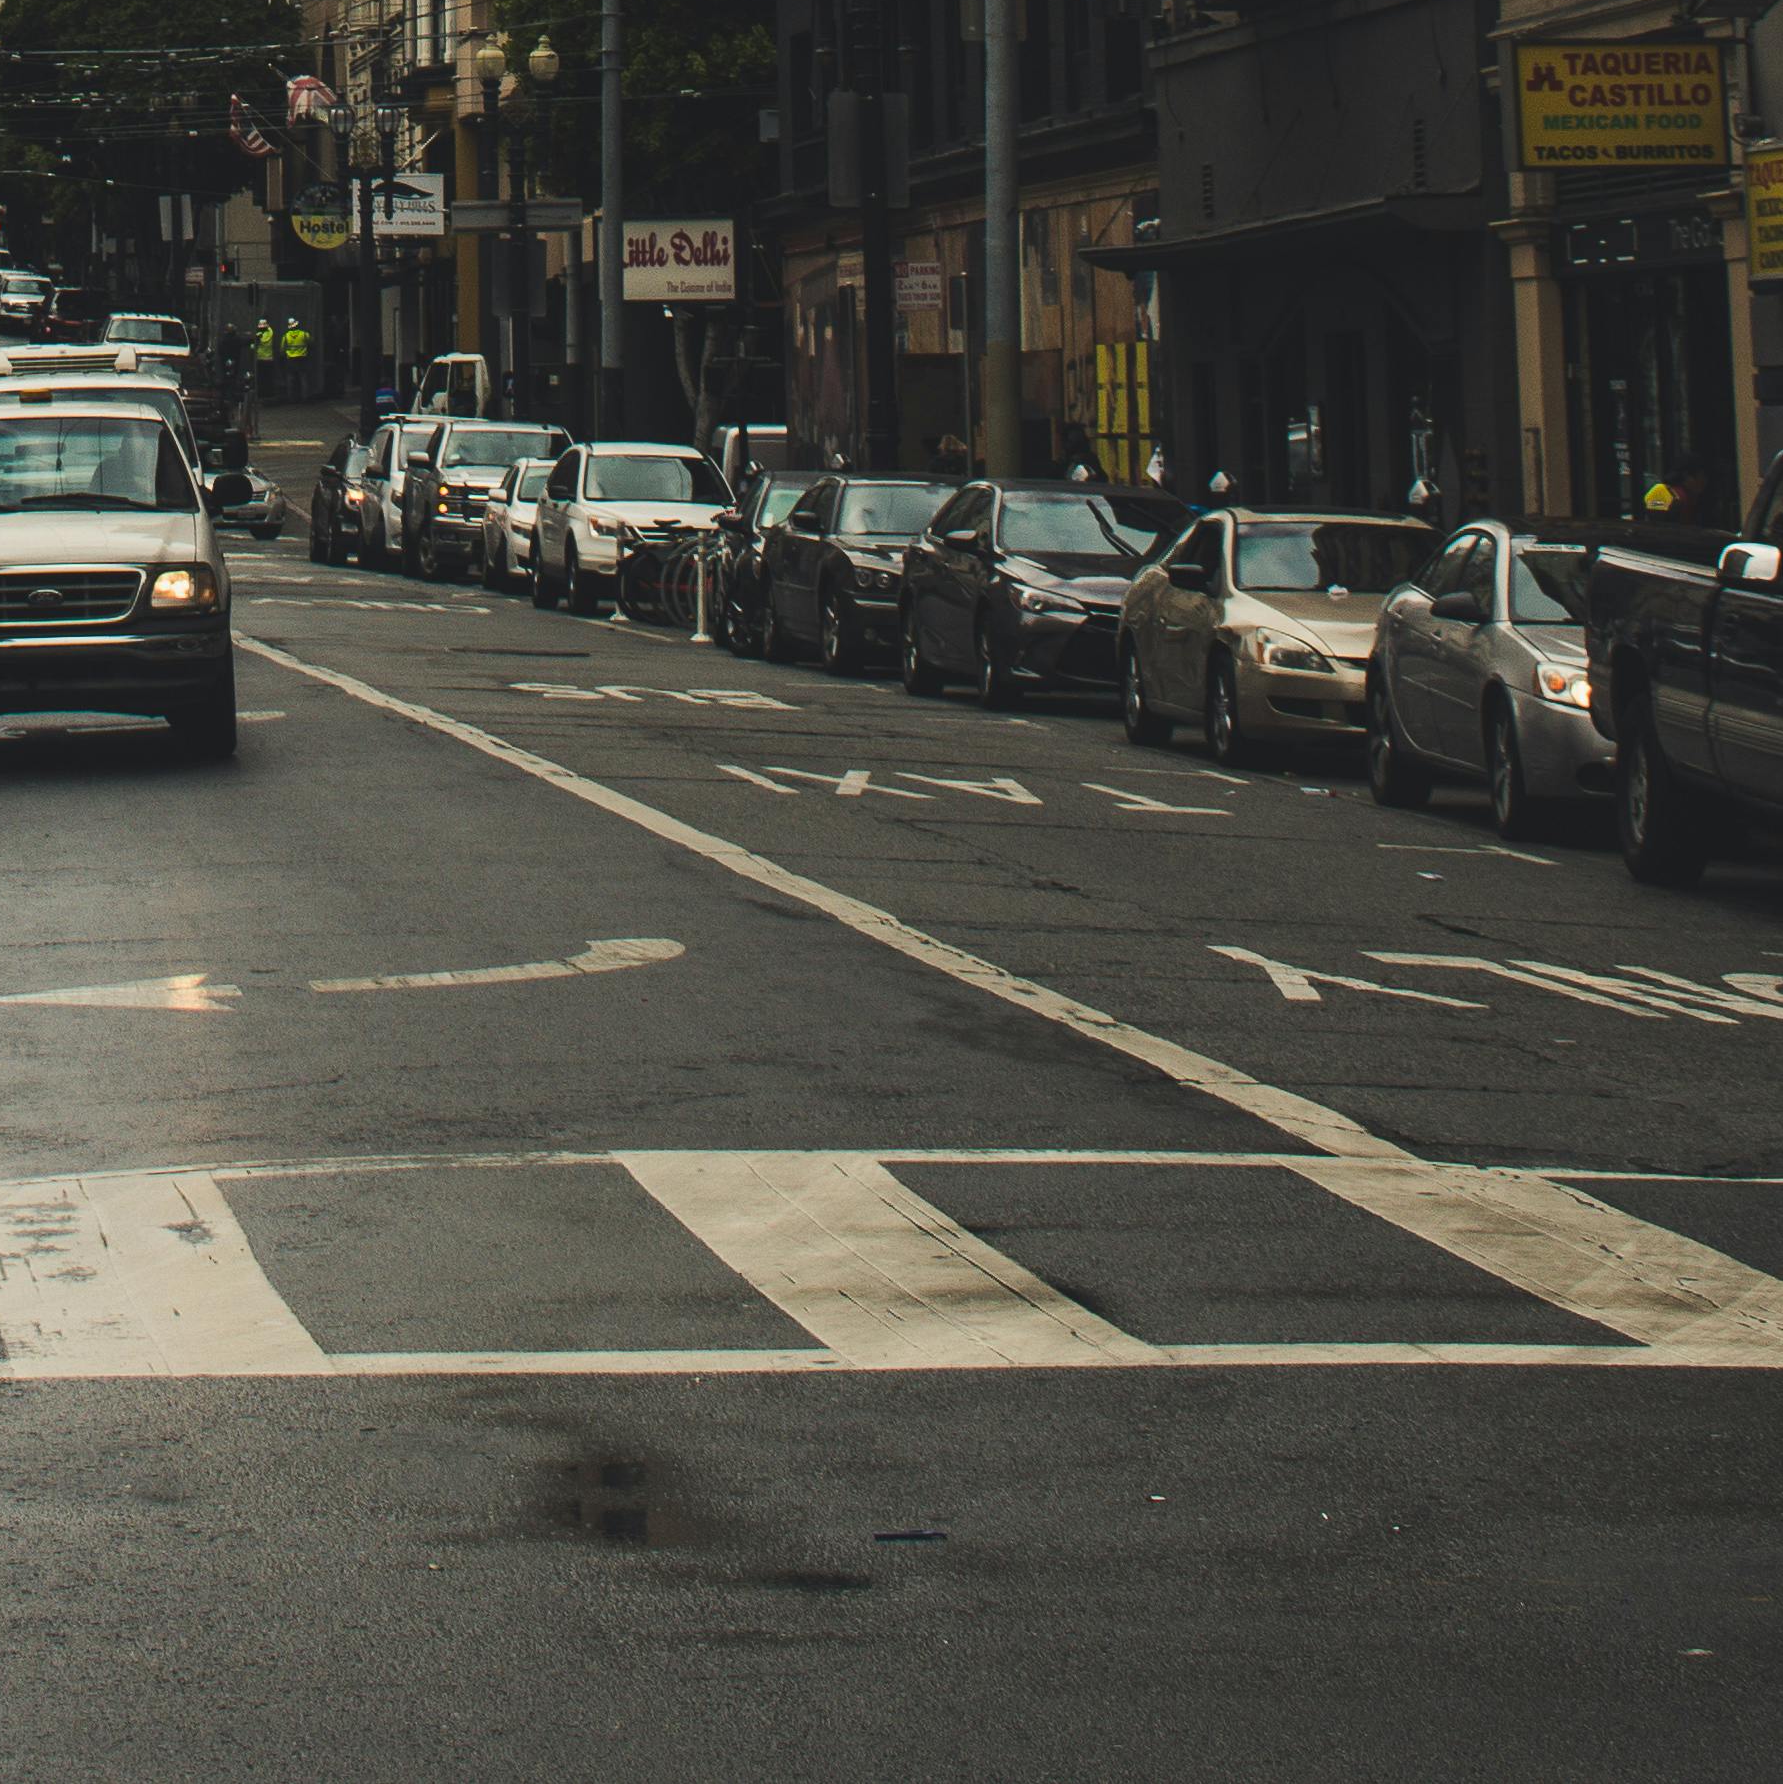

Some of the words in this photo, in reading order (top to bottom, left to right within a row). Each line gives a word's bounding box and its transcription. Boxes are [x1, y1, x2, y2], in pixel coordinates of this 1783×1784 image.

[1562, 51, 1714, 76] TAQUERIA
[1568, 83, 1712, 107] CASTILLO
[1543, 113, 1638, 130] MEXICAN
[1645, 113, 1703, 129] FOOD
[1534, 145, 1598, 160] TACOS
[1617, 144, 1714, 160] BURRITOS
[299, 220, 350, 234] Hostel
[622, 231, 669, 268] ittle
[670, 228, 730, 267] Delhi
